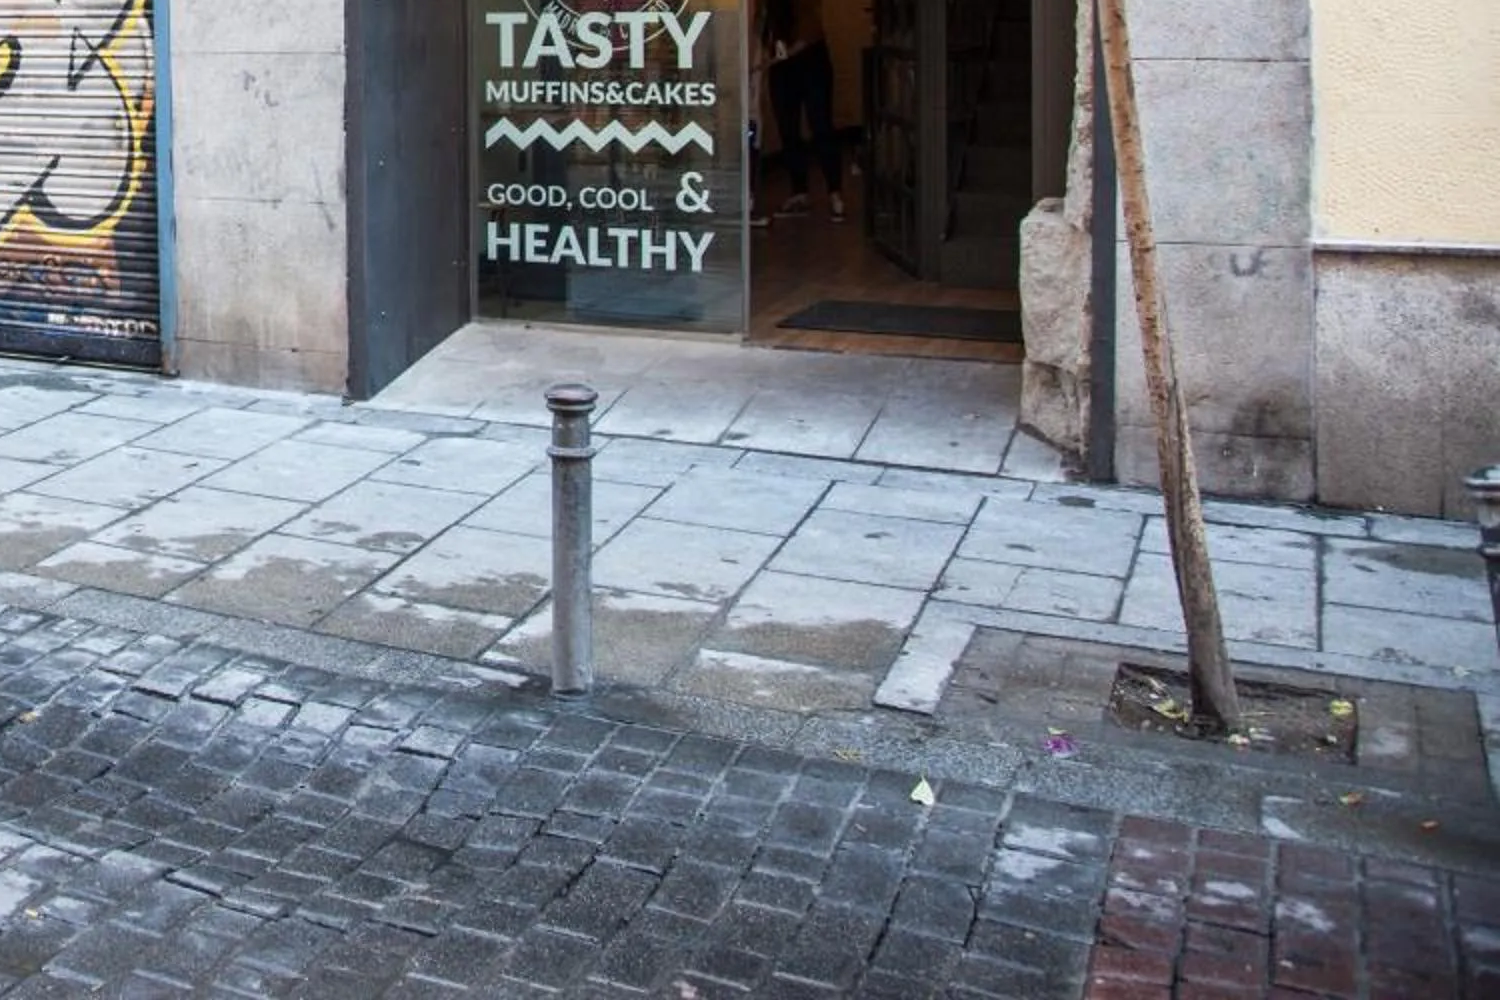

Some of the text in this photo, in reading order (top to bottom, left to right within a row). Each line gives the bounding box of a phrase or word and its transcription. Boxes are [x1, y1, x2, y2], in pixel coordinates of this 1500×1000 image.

[485, 11, 712, 70] TASTY
[485, 80, 716, 106] MUFFINS&CAKES
[487, 171, 714, 214] GOOD, COOL &
[487, 221, 715, 273] HEALTHY
